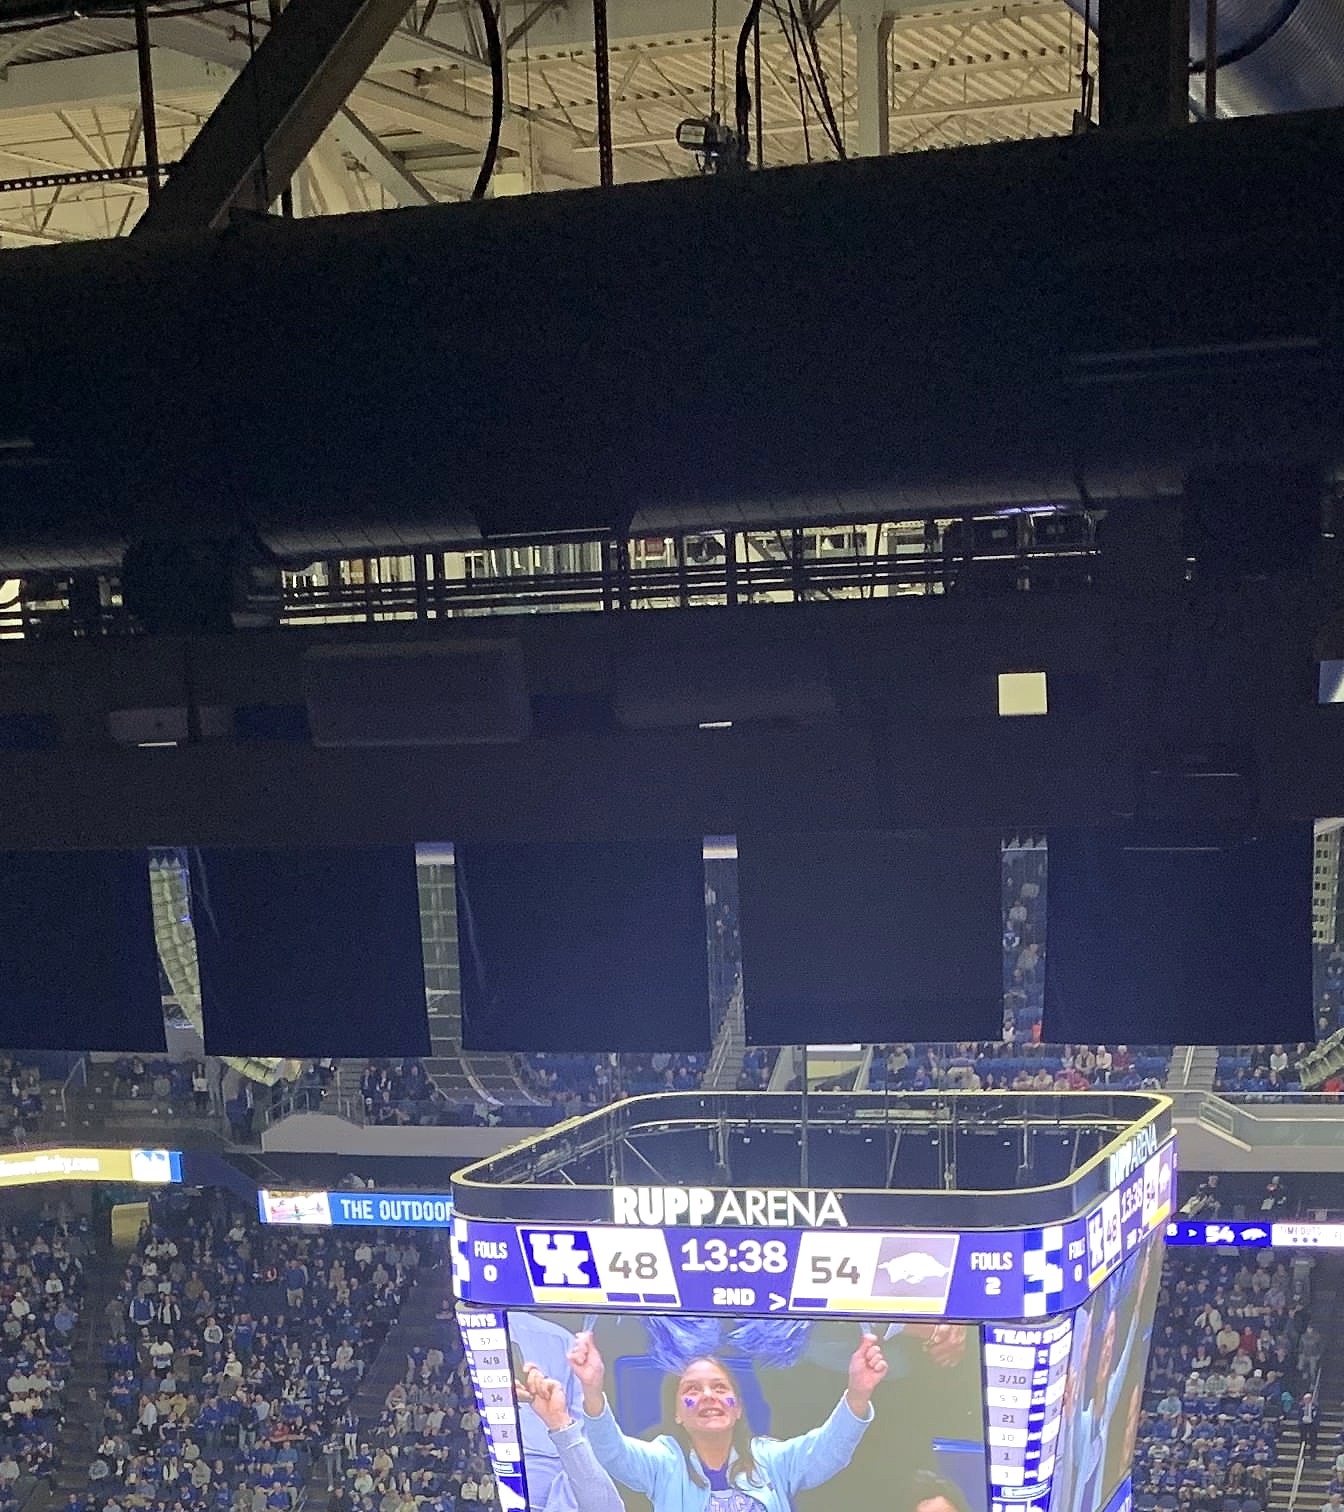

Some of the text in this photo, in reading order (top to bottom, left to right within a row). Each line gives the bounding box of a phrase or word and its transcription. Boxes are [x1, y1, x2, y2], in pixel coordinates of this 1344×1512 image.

[340, 1199, 373, 1221] THE
[613, 1187, 849, 1227] RUPP ARENA
[474, 1240, 508, 1259] FOULS
[681, 1238, 789, 1274] 13:38
[608, 1251, 659, 1280] 48
[810, 1255, 861, 1285] 54
[971, 1251, 1014, 1271] FOULS
[483, 1264, 498, 1282] 0
[984, 1277, 1002, 1296] 2
[712, 1287, 756, 1306] 2ND
[993, 1328, 1042, 1345] TEAM
[998, 1374, 1027, 1385] 3/10
[1001, 1414, 1015, 1424] 21
